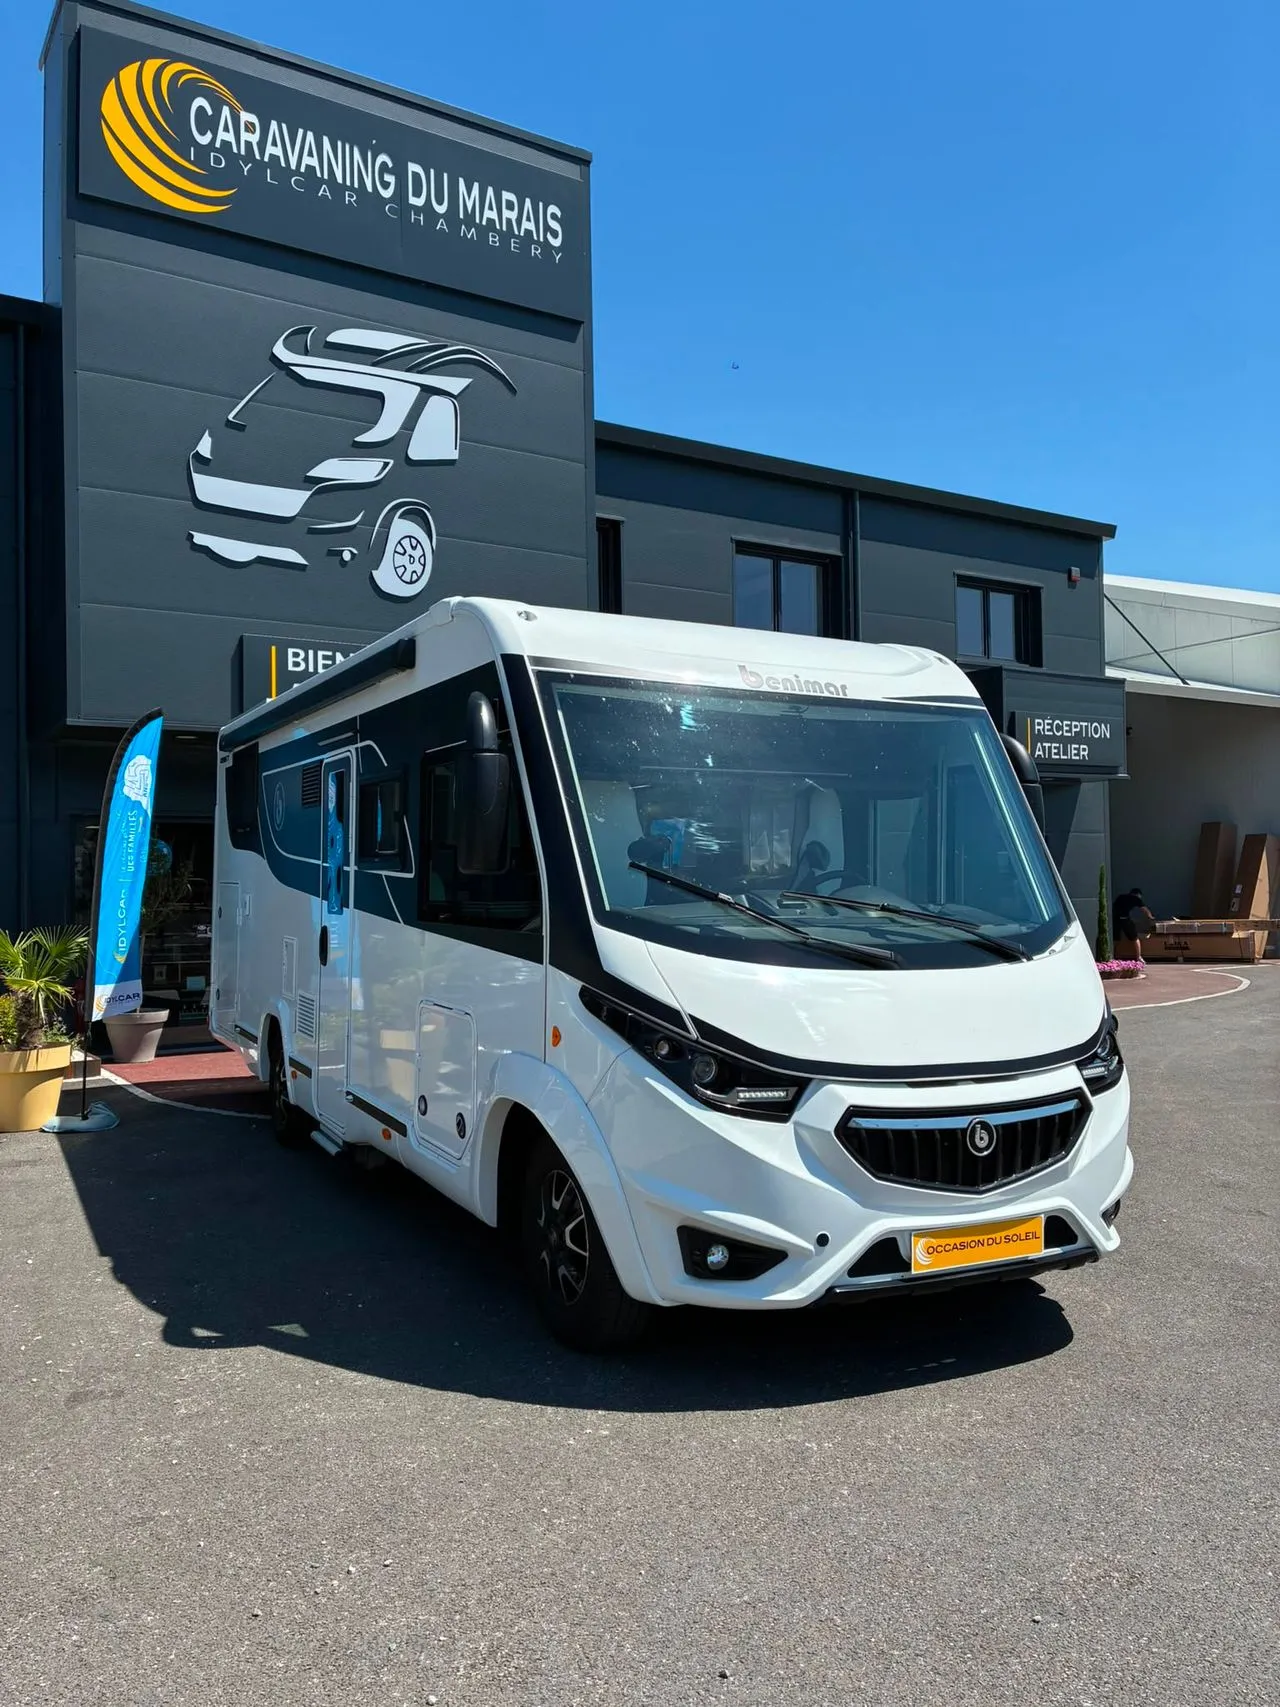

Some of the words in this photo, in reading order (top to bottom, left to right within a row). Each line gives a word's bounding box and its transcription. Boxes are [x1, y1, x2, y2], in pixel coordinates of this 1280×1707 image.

[190, 96, 395, 198] CARAVANING
[407, 161, 449, 214] DU
[458, 177, 562, 247] MARAIS
[190, 146, 358, 207] IDYLCAR
[385, 203, 562, 264] CHAMBERY
[737, 664, 848, 697] benimar
[1034, 716, 1110, 739] RÉCEPTION
[1034, 742, 1089, 760] ATELIER
[127, 810, 138, 853] FAMILLES
[926, 1239, 985, 1255] OCCASION
[986, 1236, 1002, 1246] DU
[1004, 1231, 1040, 1243] SOLEIL
